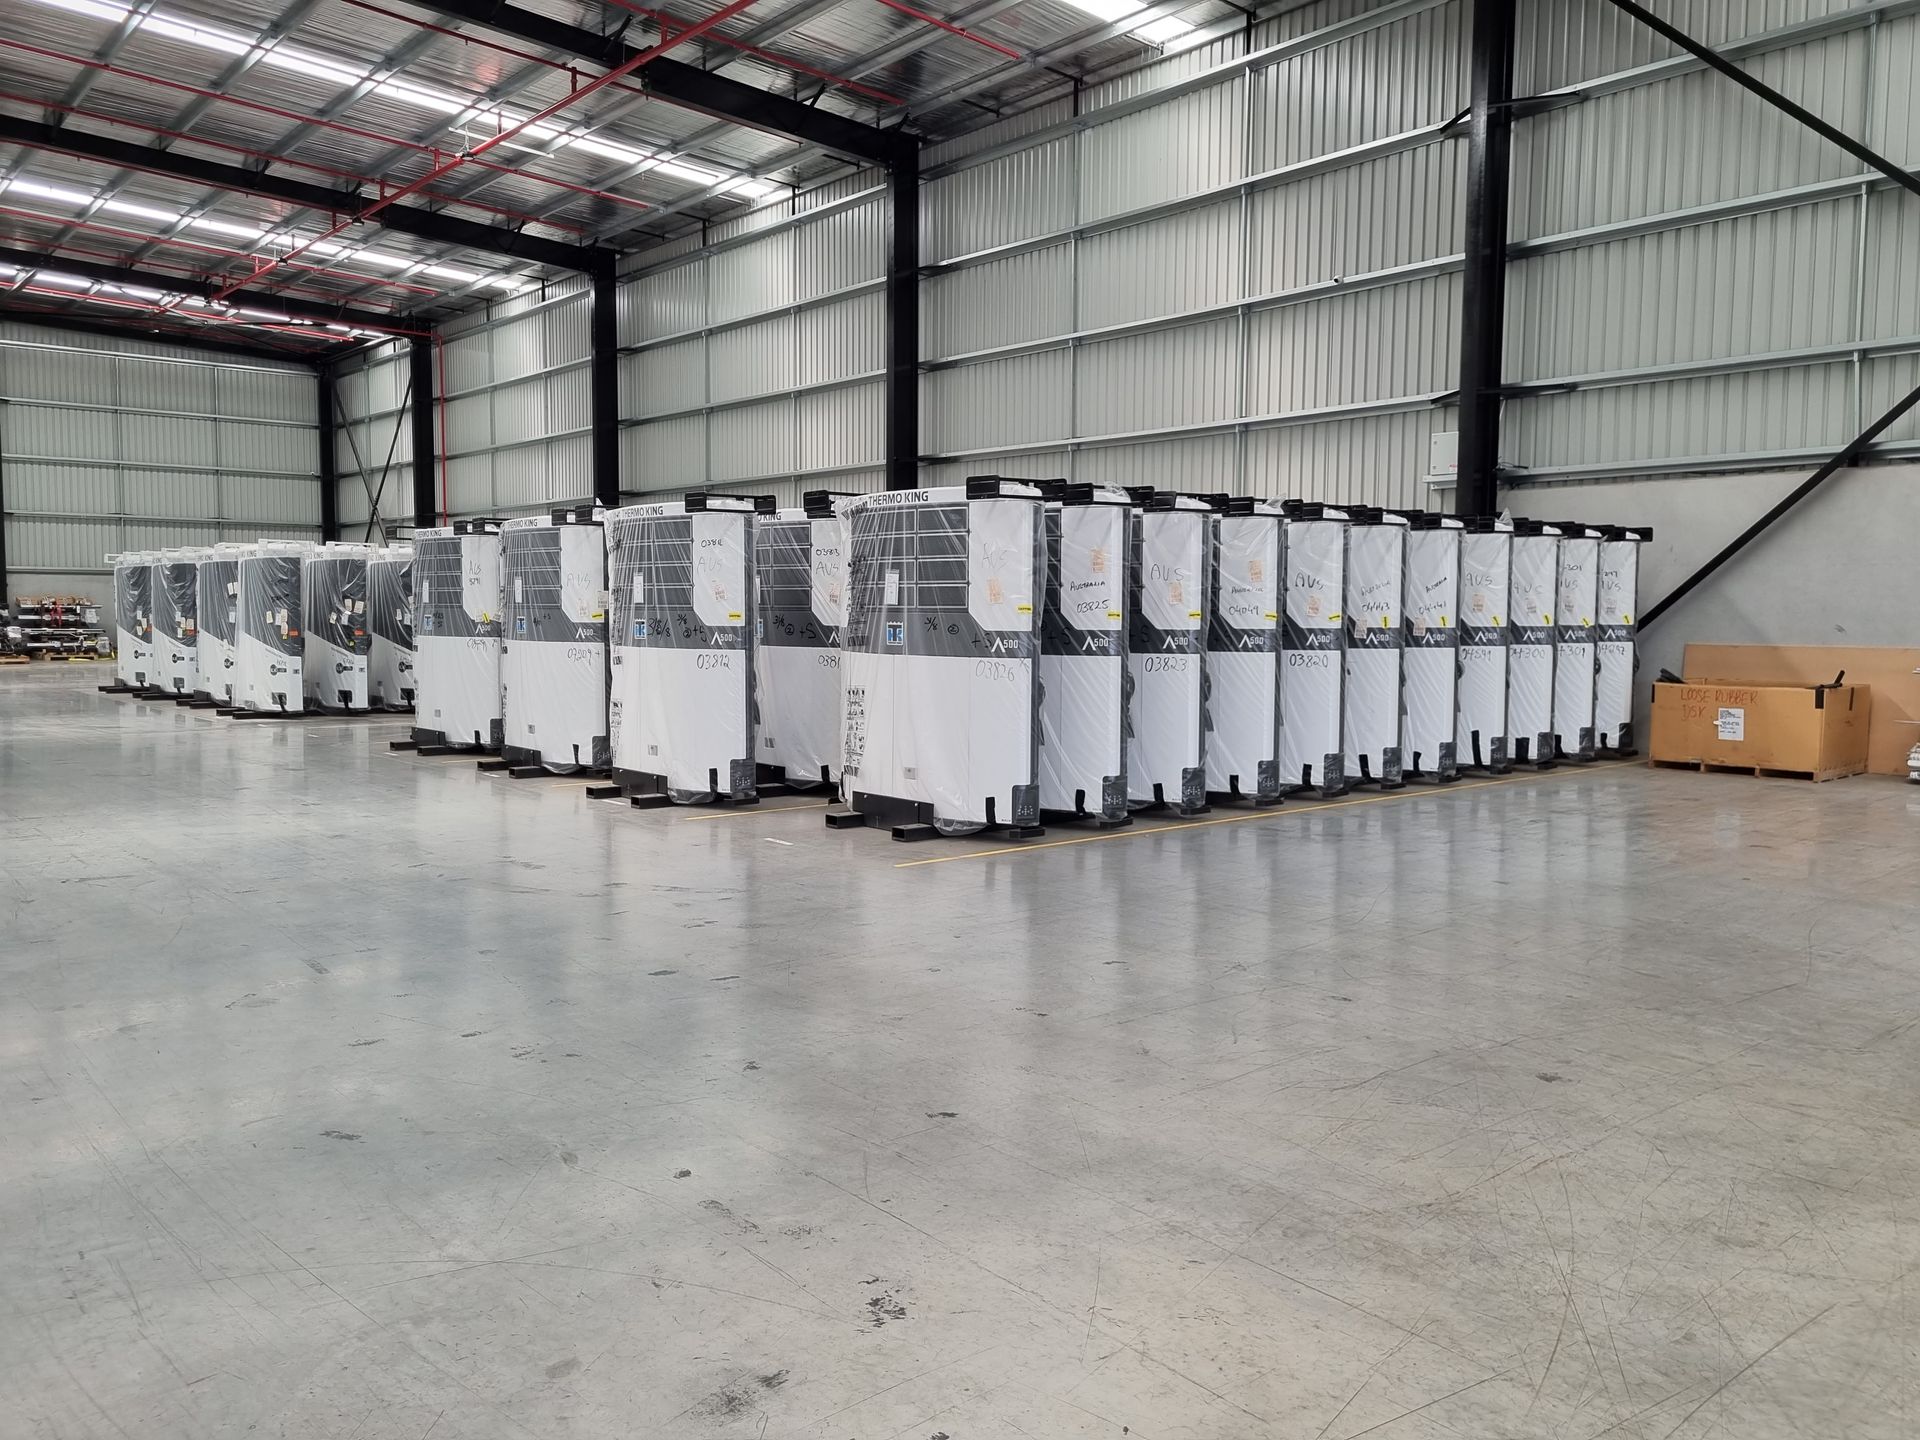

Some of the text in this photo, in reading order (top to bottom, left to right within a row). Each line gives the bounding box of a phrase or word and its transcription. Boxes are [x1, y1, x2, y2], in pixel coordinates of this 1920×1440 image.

[869, 491, 929, 506] THERMO KING
[645, 505, 664, 516] KING
[524, 518, 538, 528] KING
[815, 561, 839, 577] AUS
[1150, 563, 1184, 581] AUS
[566, 572, 591, 591] AUS
[1295, 572, 1325, 590] AUS
[1076, 599, 1111, 614] 03825
[1145, 656, 1187, 673] 03823
[1289, 653, 1329, 668] 03820
[975, 659, 1015, 682] 03826
[1680, 688, 1759, 705] LOOSE RUBBER
